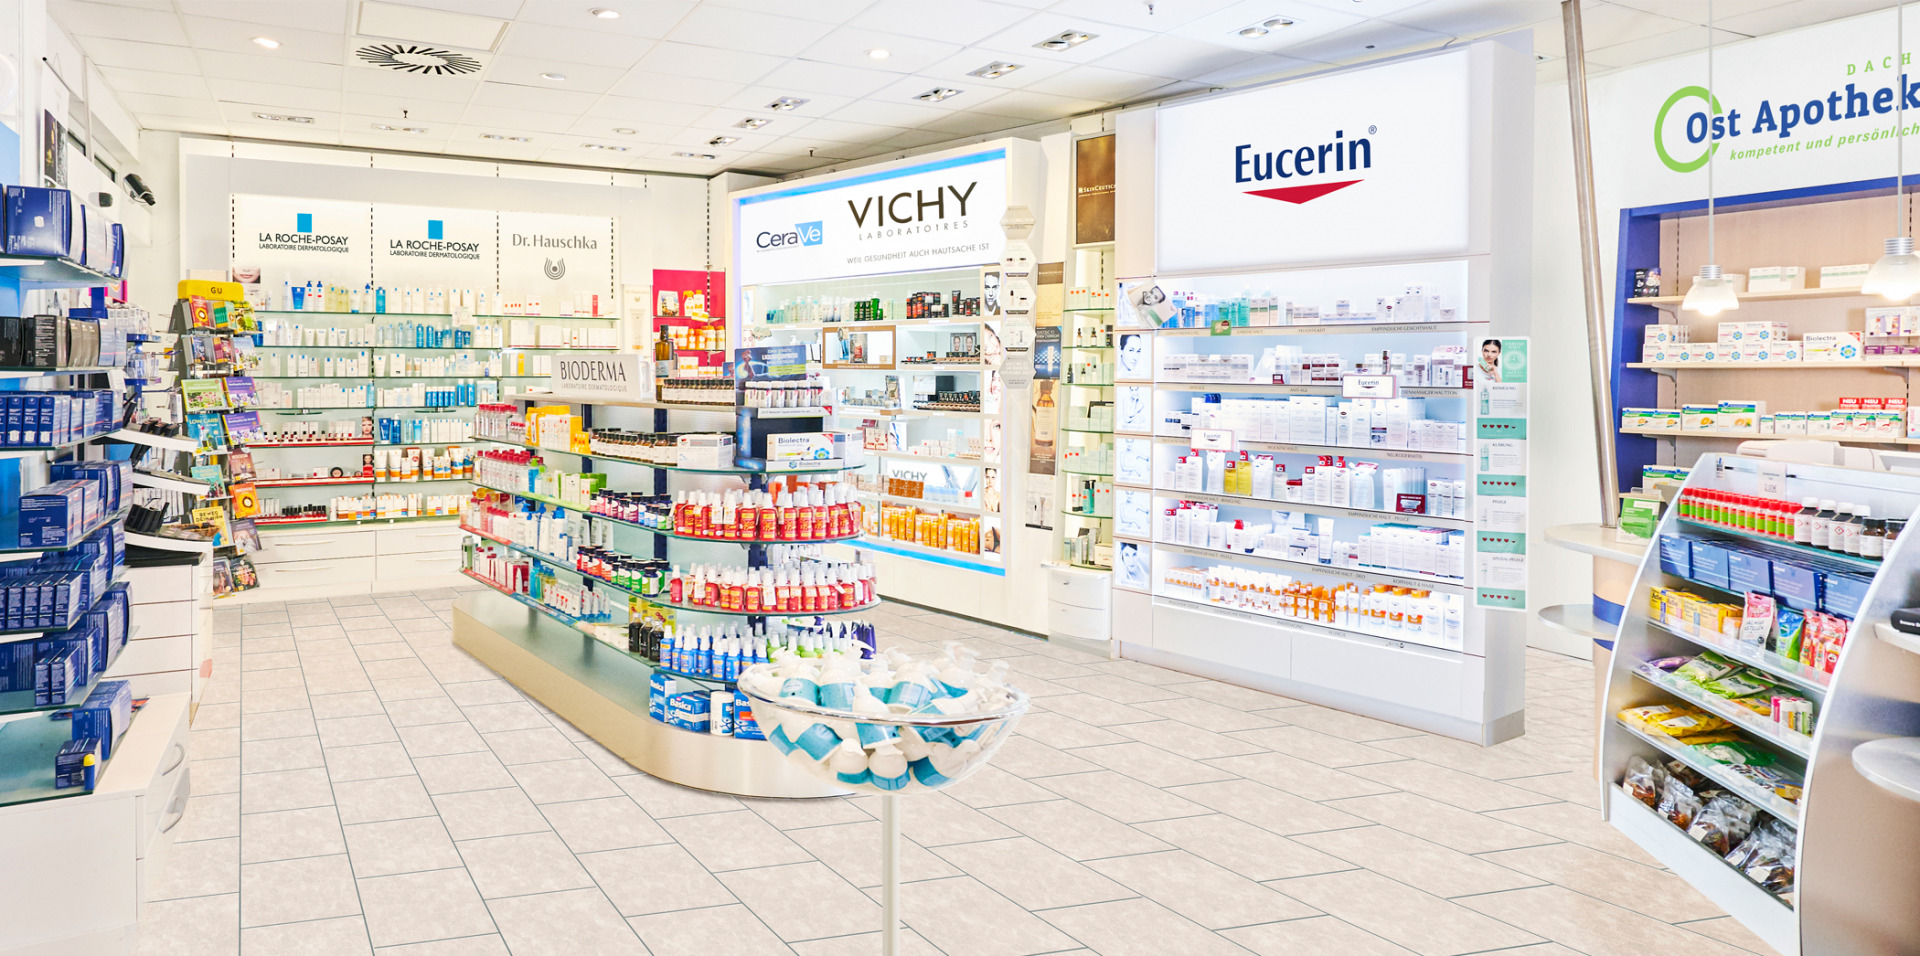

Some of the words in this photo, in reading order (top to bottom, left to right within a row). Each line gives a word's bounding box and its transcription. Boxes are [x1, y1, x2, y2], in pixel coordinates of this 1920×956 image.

[1846, 53, 1912, 76] DACH
[1686, 109, 1741, 144] Ost
[1730, 141, 1801, 161] kompetent
[1806, 135, 1833, 150] und
[1837, 122, 1920, 149] persönlch
[847, 181, 978, 229] VICHY
[259, 233, 273, 242] LA
[275, 234, 349, 246] ROCHE-POSAY
[756, 225, 821, 249] CeraVe
[858, 220, 969, 241] LABORATOIRES
[259, 243, 297, 251] LABORATOIRE
[298, 245, 349, 253] DERMATOLOGIQUE
[390, 239, 403, 249] LA
[406, 240, 480, 252] ROCHE-POSAY
[512, 233, 531, 247] Dr.
[533, 234, 598, 250] Hauschka
[390, 250, 428, 258] LABORATOIRE
[428, 251, 480, 260] DERMATOLOGIQUE
[847, 257, 862, 265] WEIL
[864, 252, 907, 263] GESUNDHEIT
[909, 249, 930, 259] AUCH
[932, 245, 977, 256] HAUTSACHE
[979, 243, 990, 251] IST
[560, 361, 627, 381] BIODERMA
[892, 469, 927, 480] VICHY
[670, 698, 692, 711] Basica
